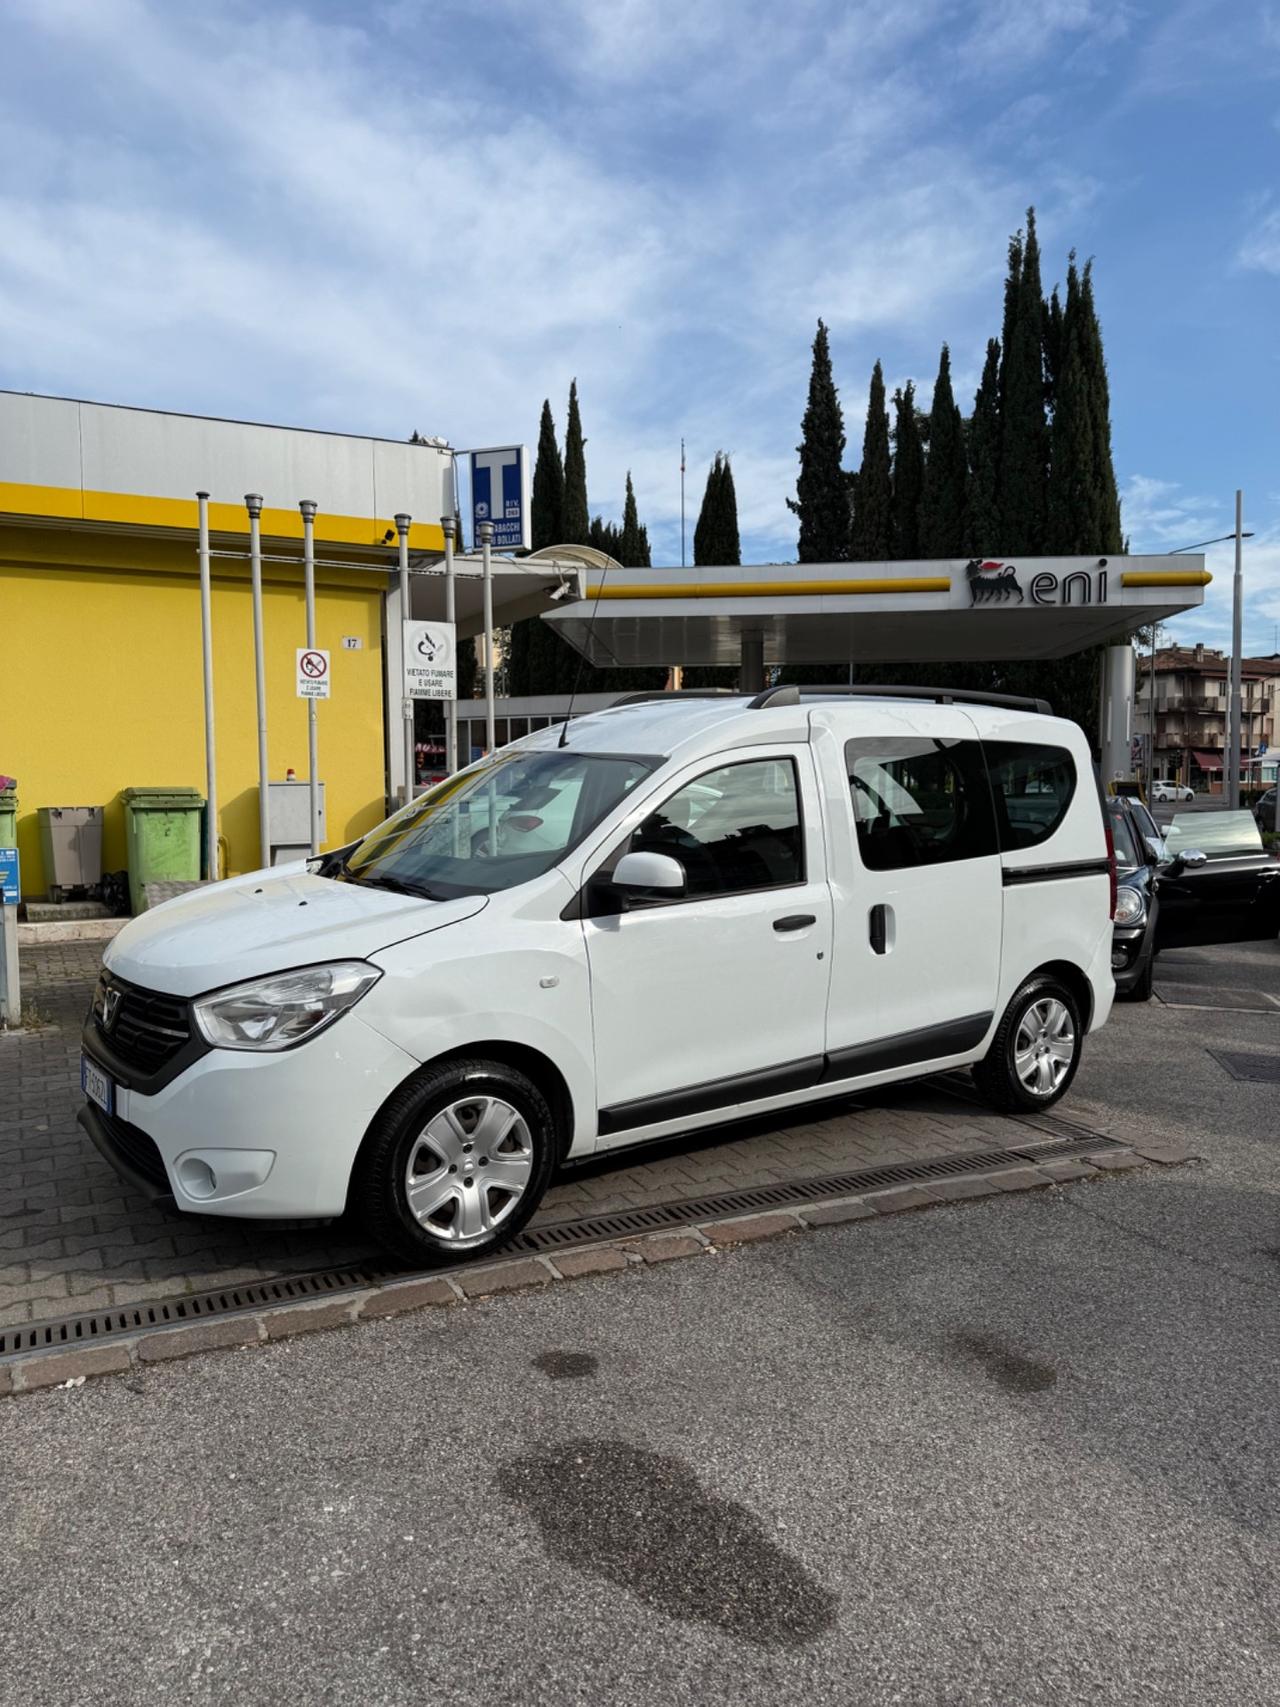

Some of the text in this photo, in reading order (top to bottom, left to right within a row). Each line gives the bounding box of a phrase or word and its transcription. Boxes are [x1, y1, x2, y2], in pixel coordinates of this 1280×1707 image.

[475, 450, 517, 519] T
[494, 522, 520, 532] ABACCHI
[1031, 558, 1107, 604] eni
[347, 639, 357, 648] 17
[407, 668, 454, 678] VIETATO FUMARE
[424, 679, 443, 687] USARE
[409, 688, 452, 698] FIAMME LIBERE
